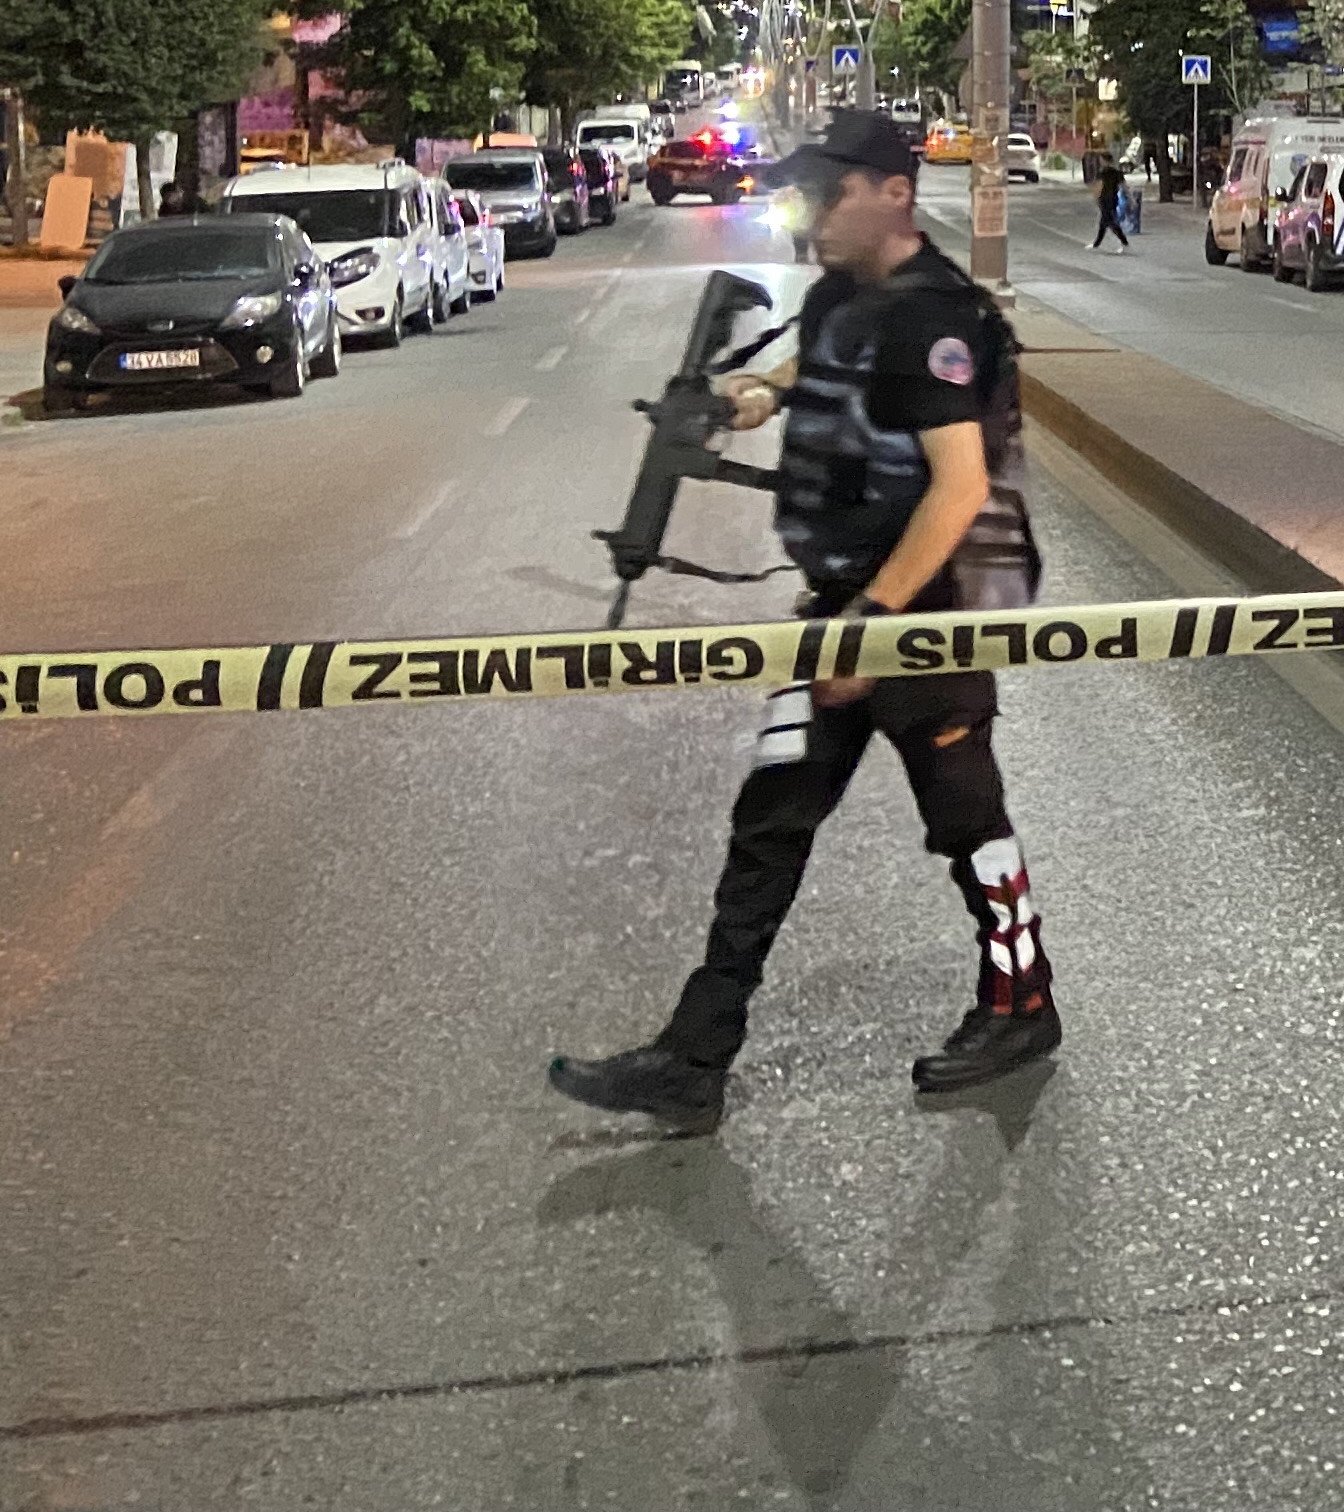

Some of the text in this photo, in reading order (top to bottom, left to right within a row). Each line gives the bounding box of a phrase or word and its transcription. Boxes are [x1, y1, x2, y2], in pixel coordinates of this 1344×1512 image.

[347, 636, 764, 701] GİRİLMEZ
[896, 617, 1138, 670] POLİS
[0, 659, 221, 713] POLİ
